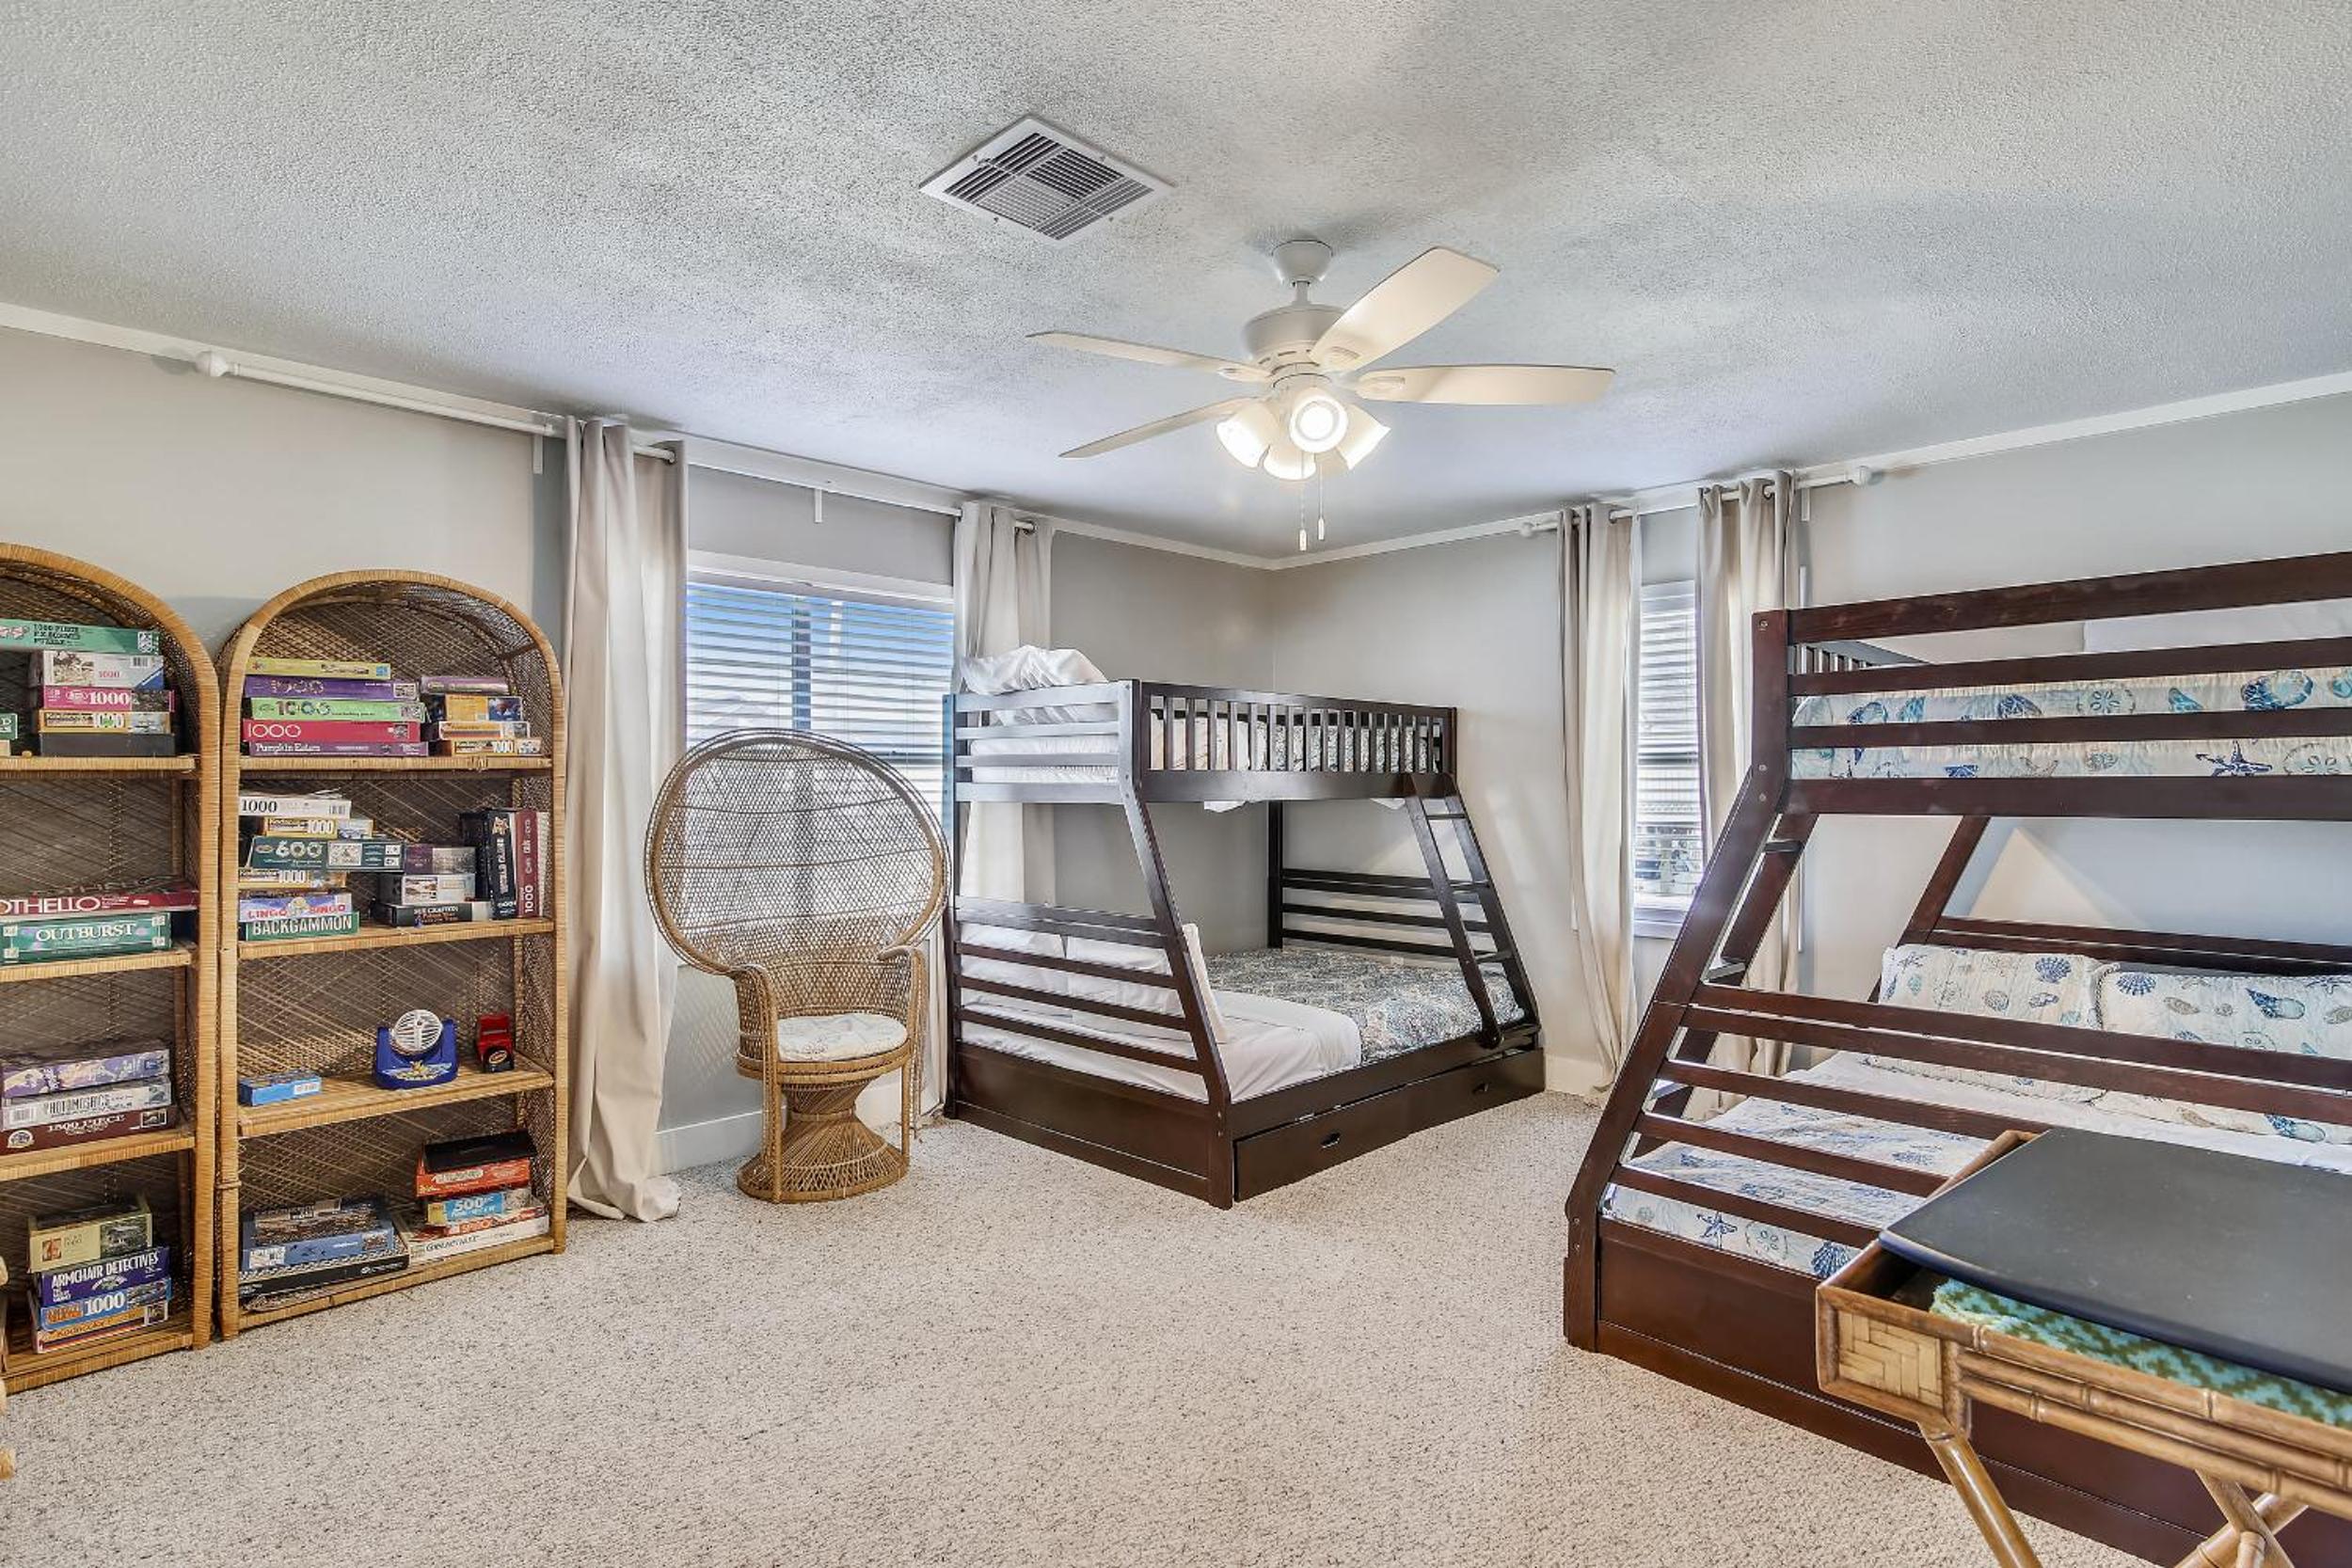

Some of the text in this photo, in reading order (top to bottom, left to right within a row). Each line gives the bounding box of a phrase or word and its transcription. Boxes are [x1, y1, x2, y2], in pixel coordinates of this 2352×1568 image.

[88, 691, 131, 705] 1000
[247, 723, 302, 738] 1000
[241, 800, 278, 814] 1000
[307, 820, 334, 834] 1000
[276, 840, 323, 859] 600
[278, 870, 307, 884] 1000
[525, 884, 535, 913] 1000
[36, 923, 136, 942] OUTBURST
[252, 915, 353, 936] BACKGAMMON
[455, 1197, 482, 1212] 500
[52, 1251, 158, 1287] ARMCHAIR DETECTIVES
[85, 1291, 126, 1316] 1000
